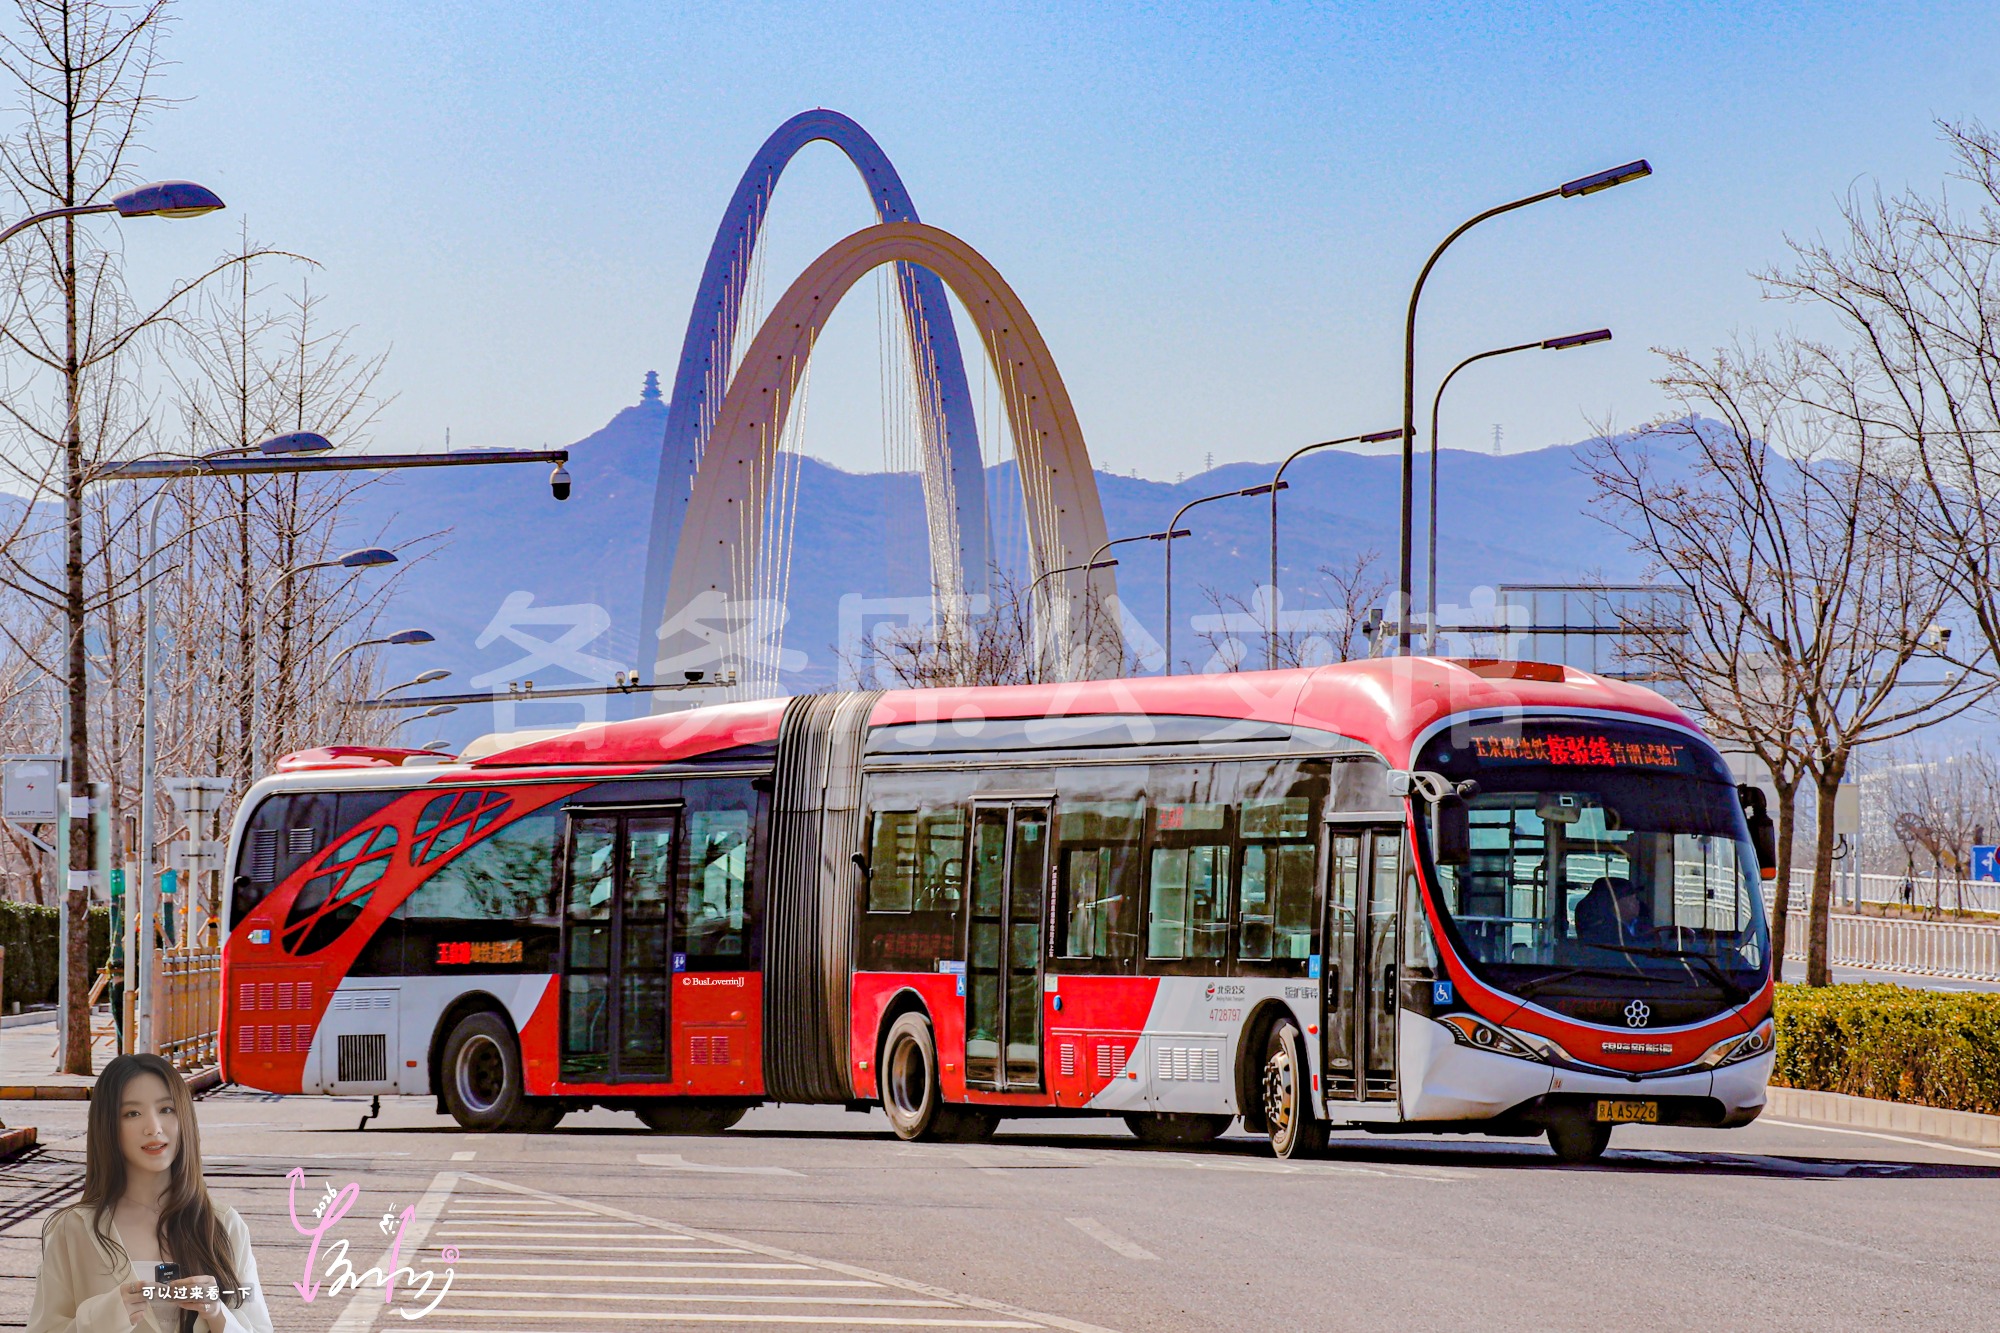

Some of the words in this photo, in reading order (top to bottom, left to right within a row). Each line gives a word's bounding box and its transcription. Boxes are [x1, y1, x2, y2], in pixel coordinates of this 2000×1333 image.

[1217, 985, 1246, 995] 北京公交
[1209, 1008, 1242, 1022] 4728797
